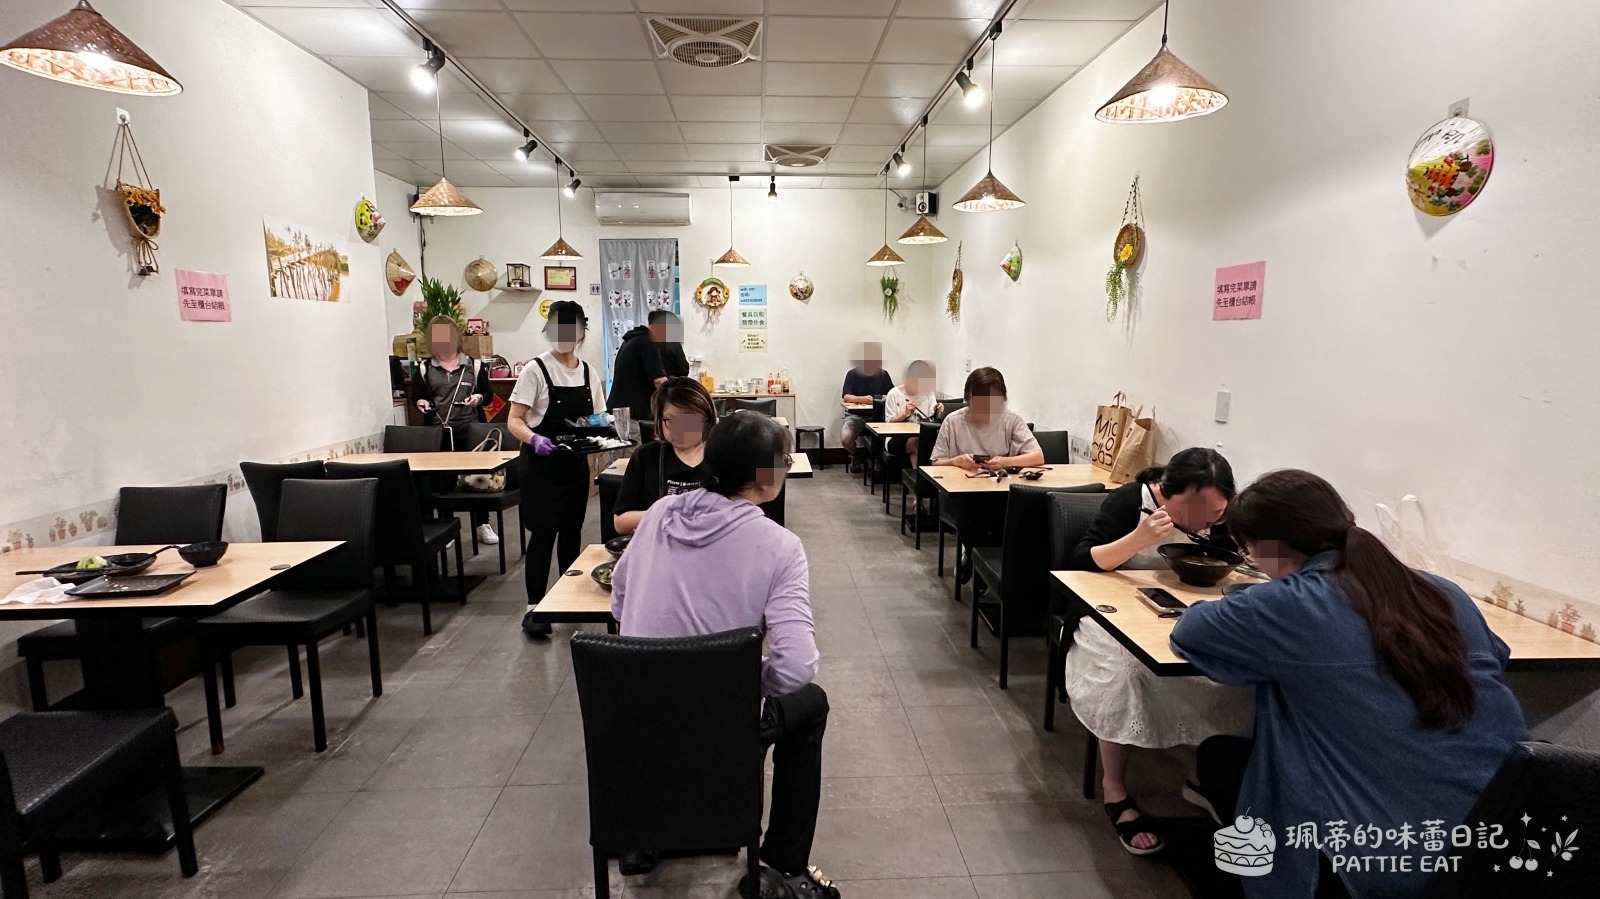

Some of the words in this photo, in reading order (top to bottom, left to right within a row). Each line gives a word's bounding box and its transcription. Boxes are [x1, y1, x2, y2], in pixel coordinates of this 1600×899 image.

[180, 285, 223, 298] 填寫完菜單請
[1216, 280, 1257, 295] 填寫完菜單請
[182, 299, 226, 310] 先至櫃台結帳
[1215, 295, 1256, 308] 先至櫃台結帳
